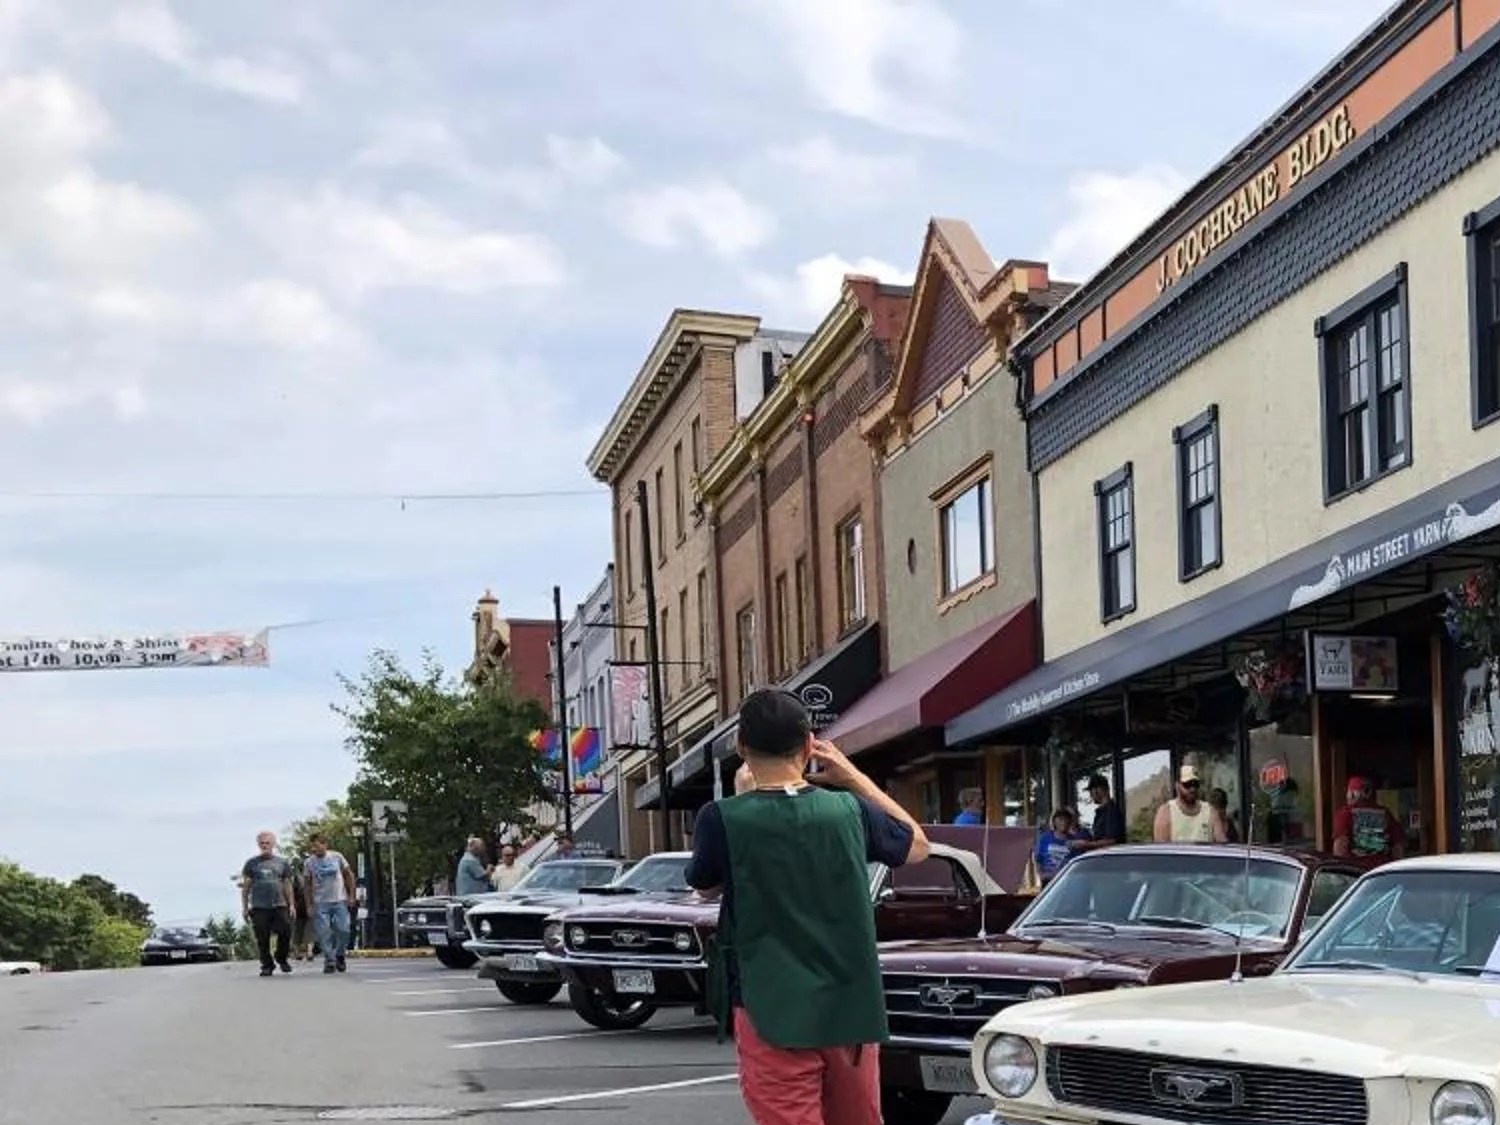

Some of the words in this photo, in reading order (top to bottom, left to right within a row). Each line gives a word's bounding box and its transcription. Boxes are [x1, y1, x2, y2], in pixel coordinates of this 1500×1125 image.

[1154, 254, 1173, 292] J.
[1174, 162, 1281, 277] COCHRANE
[1287, 103, 1357, 189] BLDG.
[1346, 549, 1371, 577] MAIN
[1372, 532, 1410, 568] STREET
